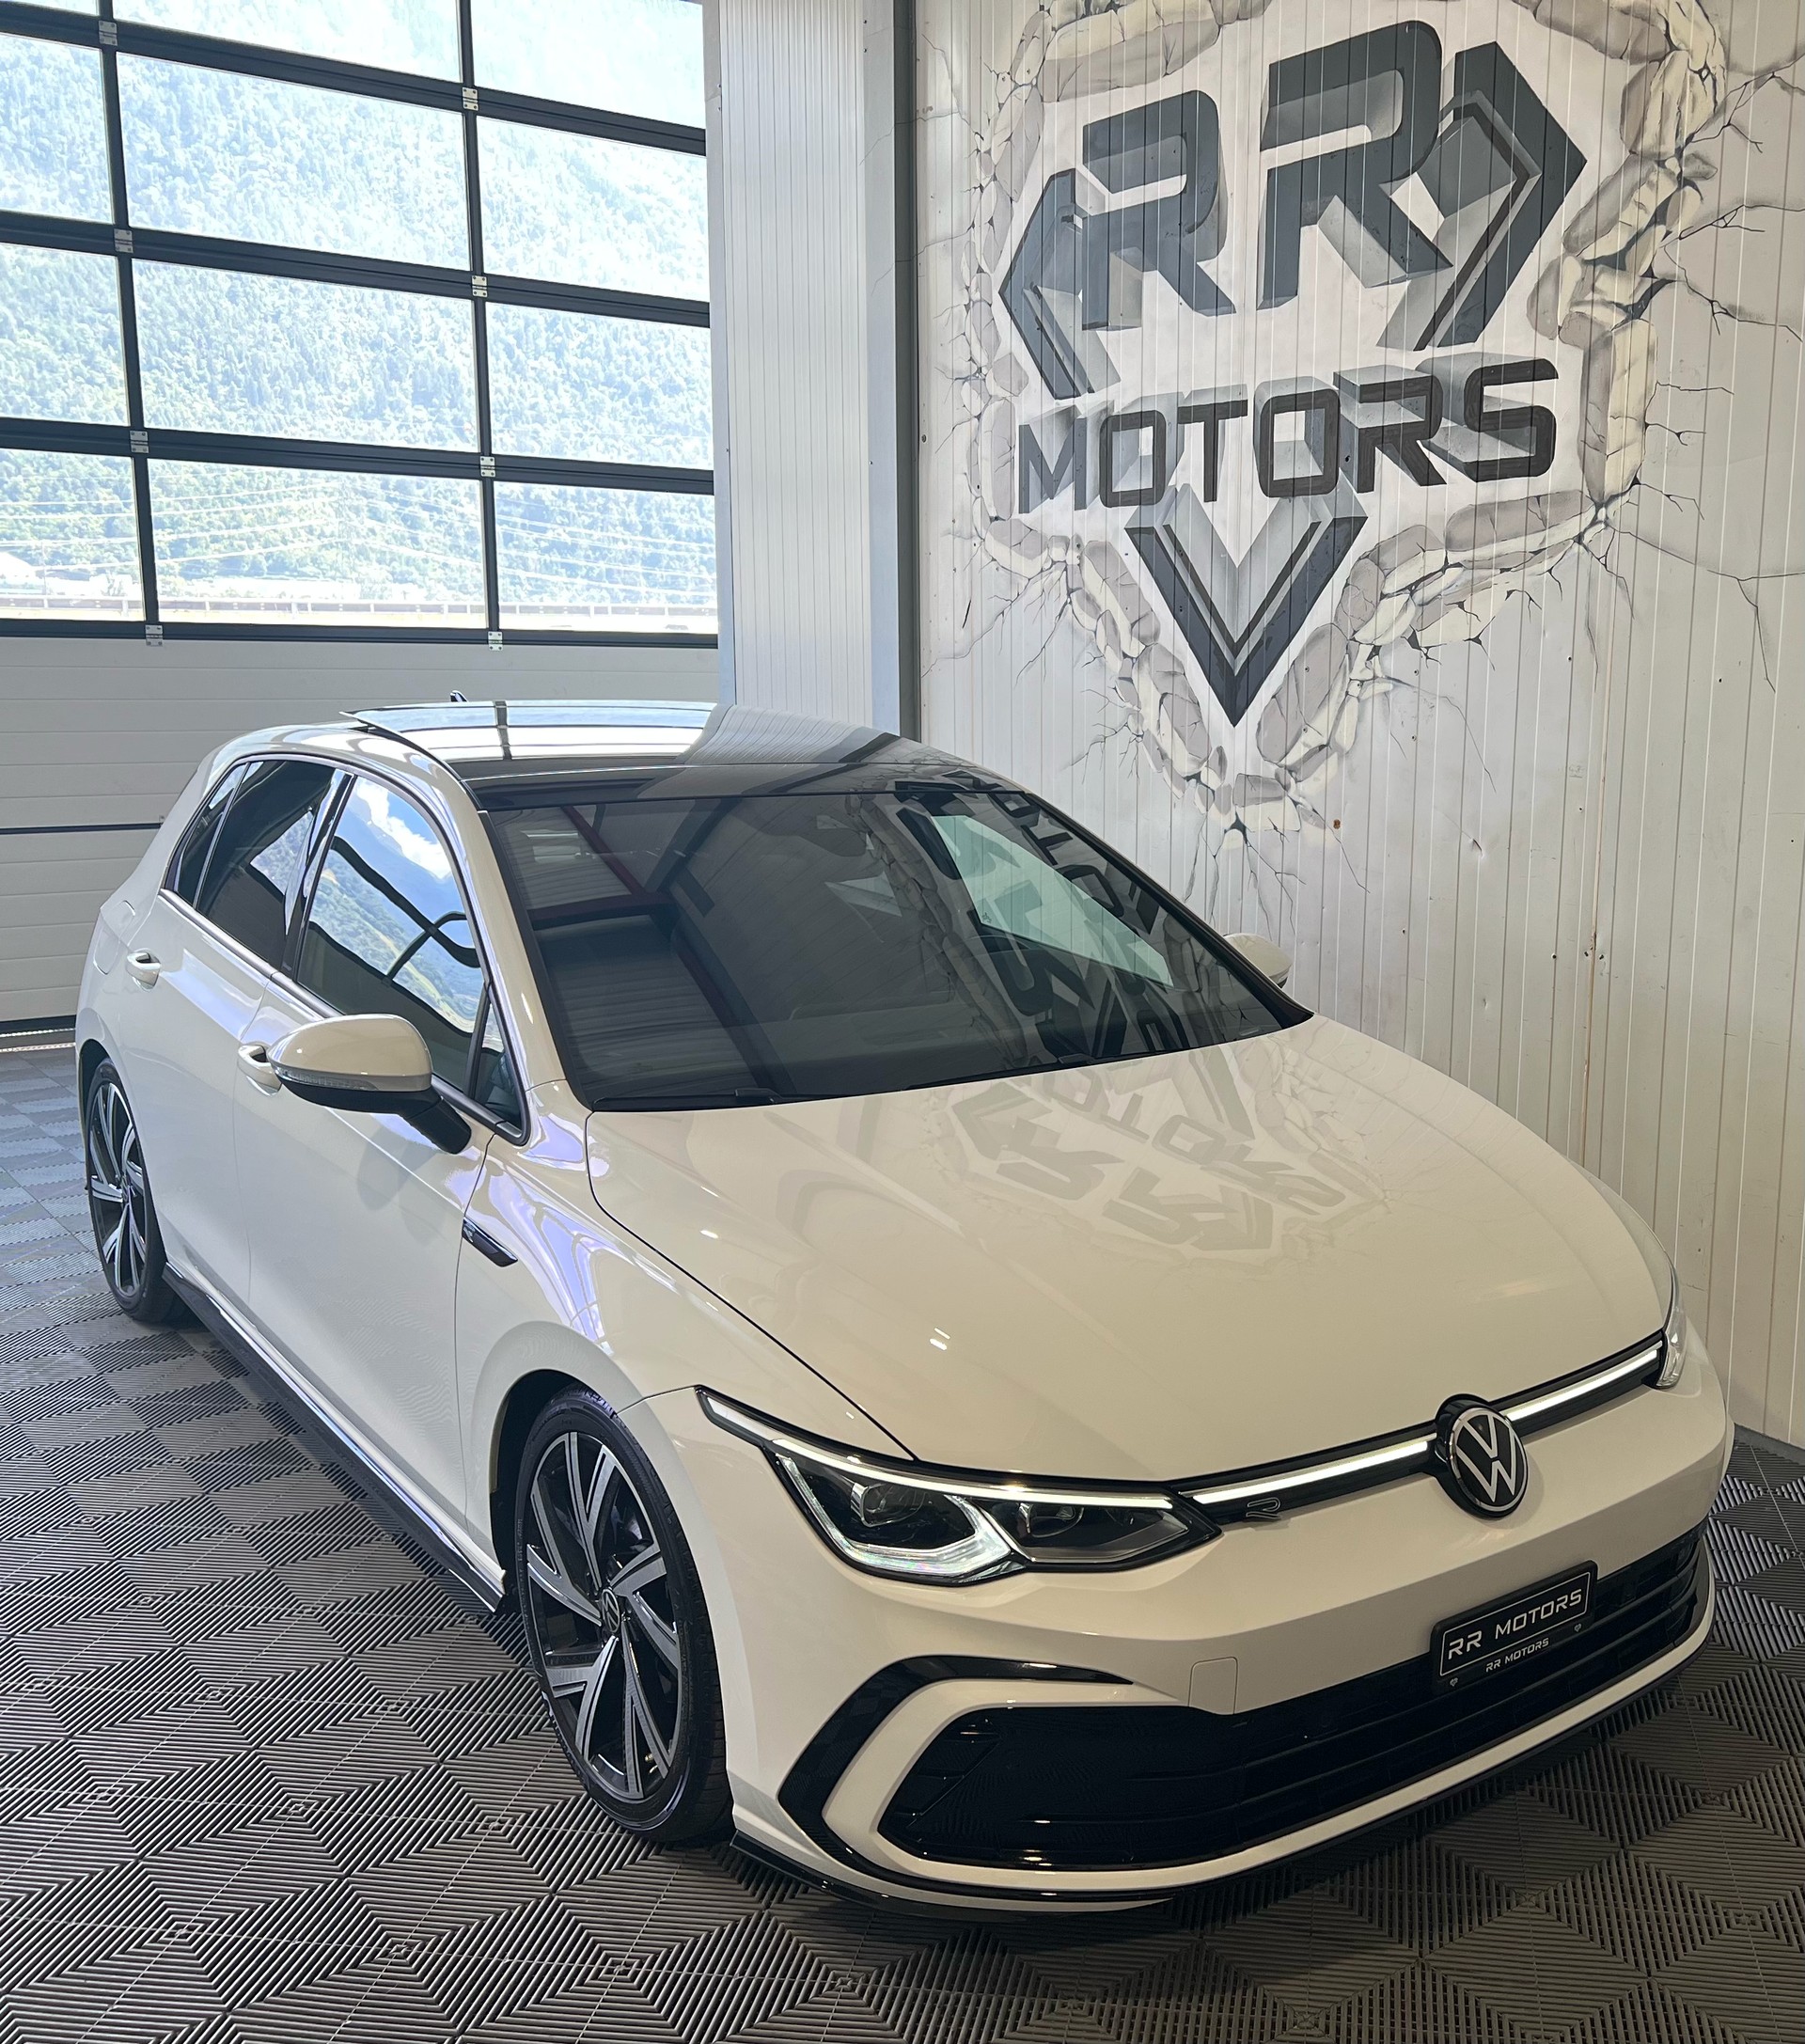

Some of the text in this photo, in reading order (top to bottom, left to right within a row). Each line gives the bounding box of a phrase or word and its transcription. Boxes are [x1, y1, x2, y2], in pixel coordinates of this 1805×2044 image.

[1081, 20, 1453, 331] RR
[1017, 354, 1560, 515] MOTORS
[1448, 1588, 1583, 1660] RR MOTORS
[1485, 1637, 1549, 1673] RR MOTORS
